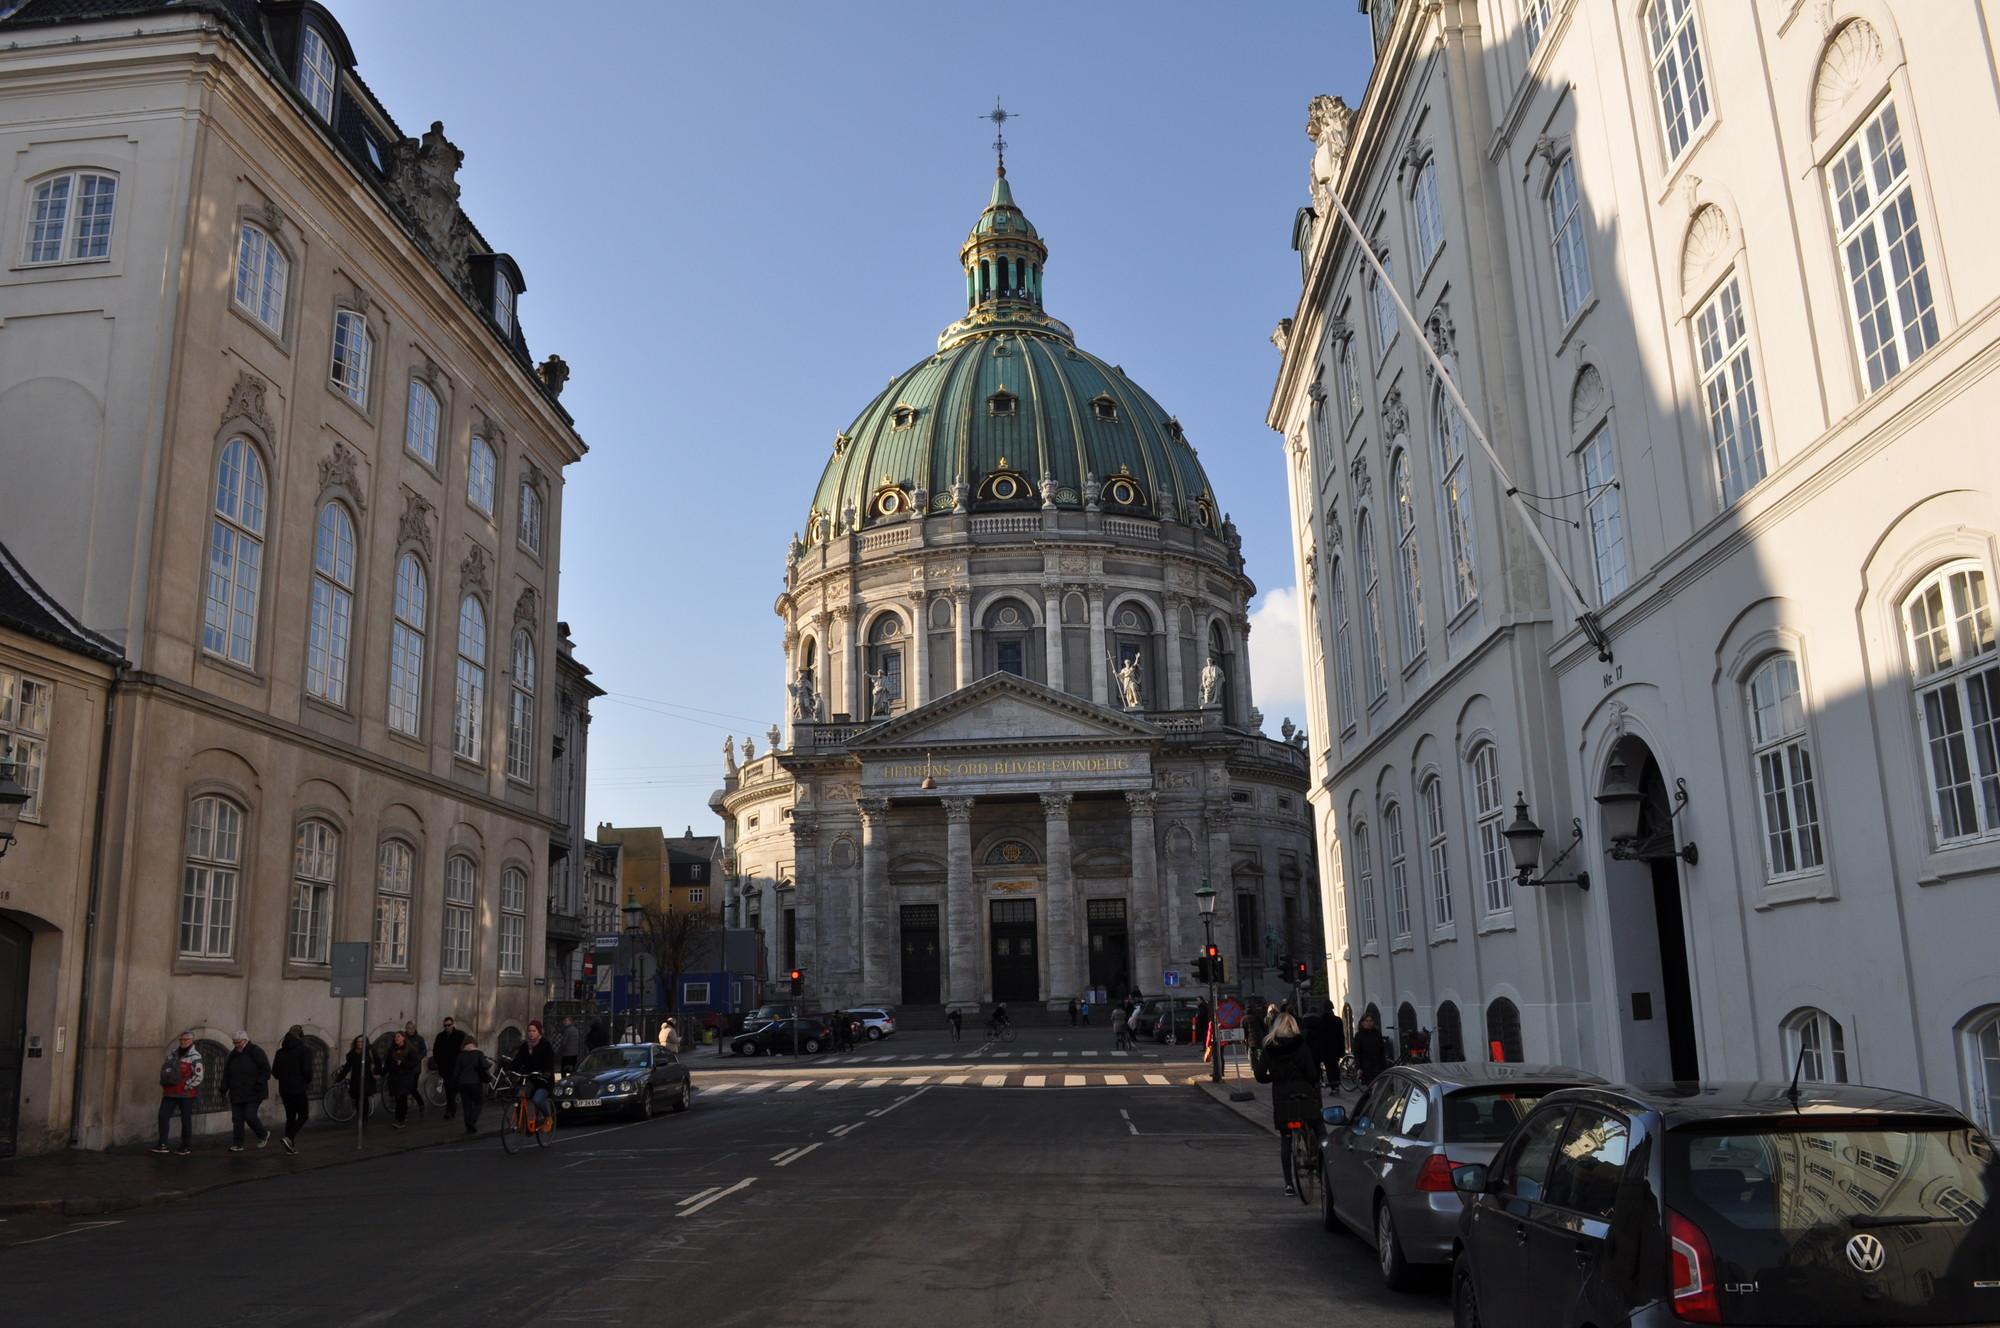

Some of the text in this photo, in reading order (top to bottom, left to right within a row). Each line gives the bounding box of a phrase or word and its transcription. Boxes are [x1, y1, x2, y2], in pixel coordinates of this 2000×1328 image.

[1616, 664, 1623, 681] 17
[884, 758, 1129, 777] HERRENS ORD BLIVER EVINDELIG
[1724, 1281, 1760, 1295] up!
